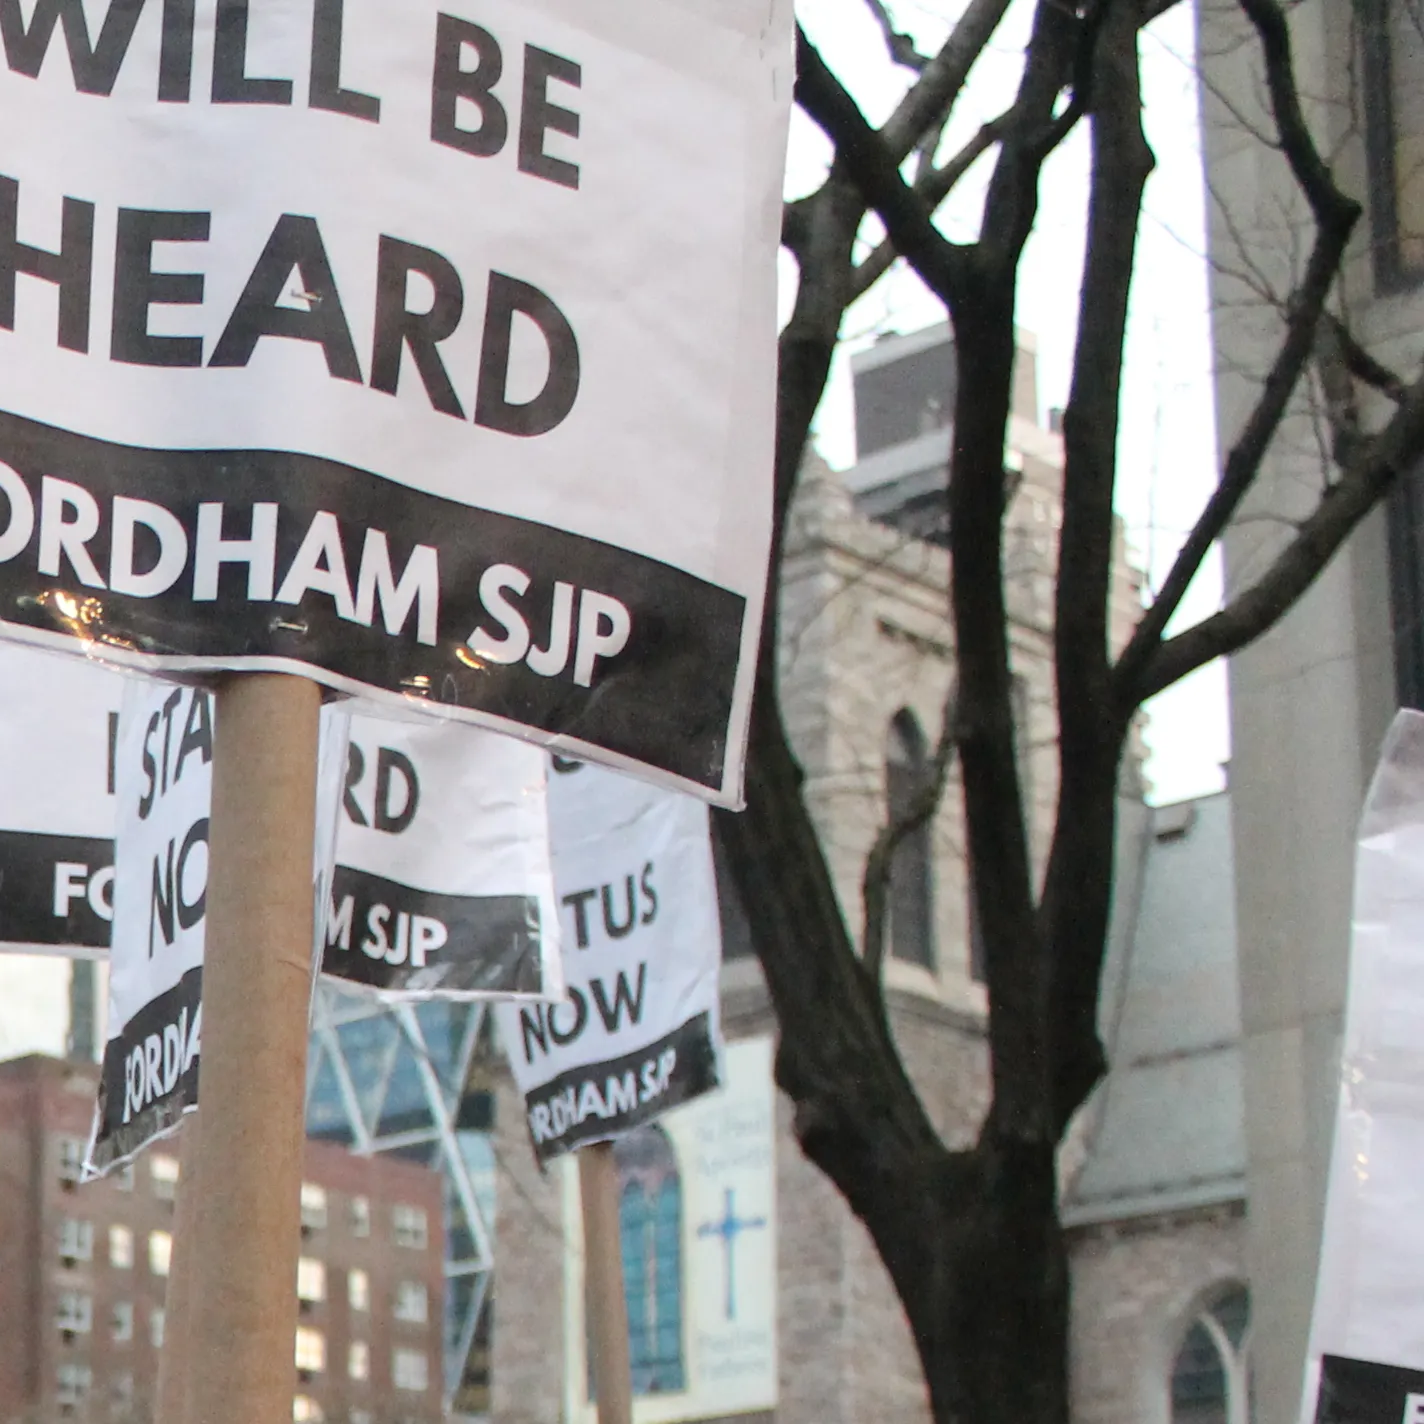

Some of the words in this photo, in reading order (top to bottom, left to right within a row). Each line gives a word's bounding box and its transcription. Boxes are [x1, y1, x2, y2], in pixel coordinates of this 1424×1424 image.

[431, 11, 582, 190] BE
[467, 562, 633, 690] SJP
[361, 902, 448, 967] SJP
[519, 961, 647, 1066] NOW
